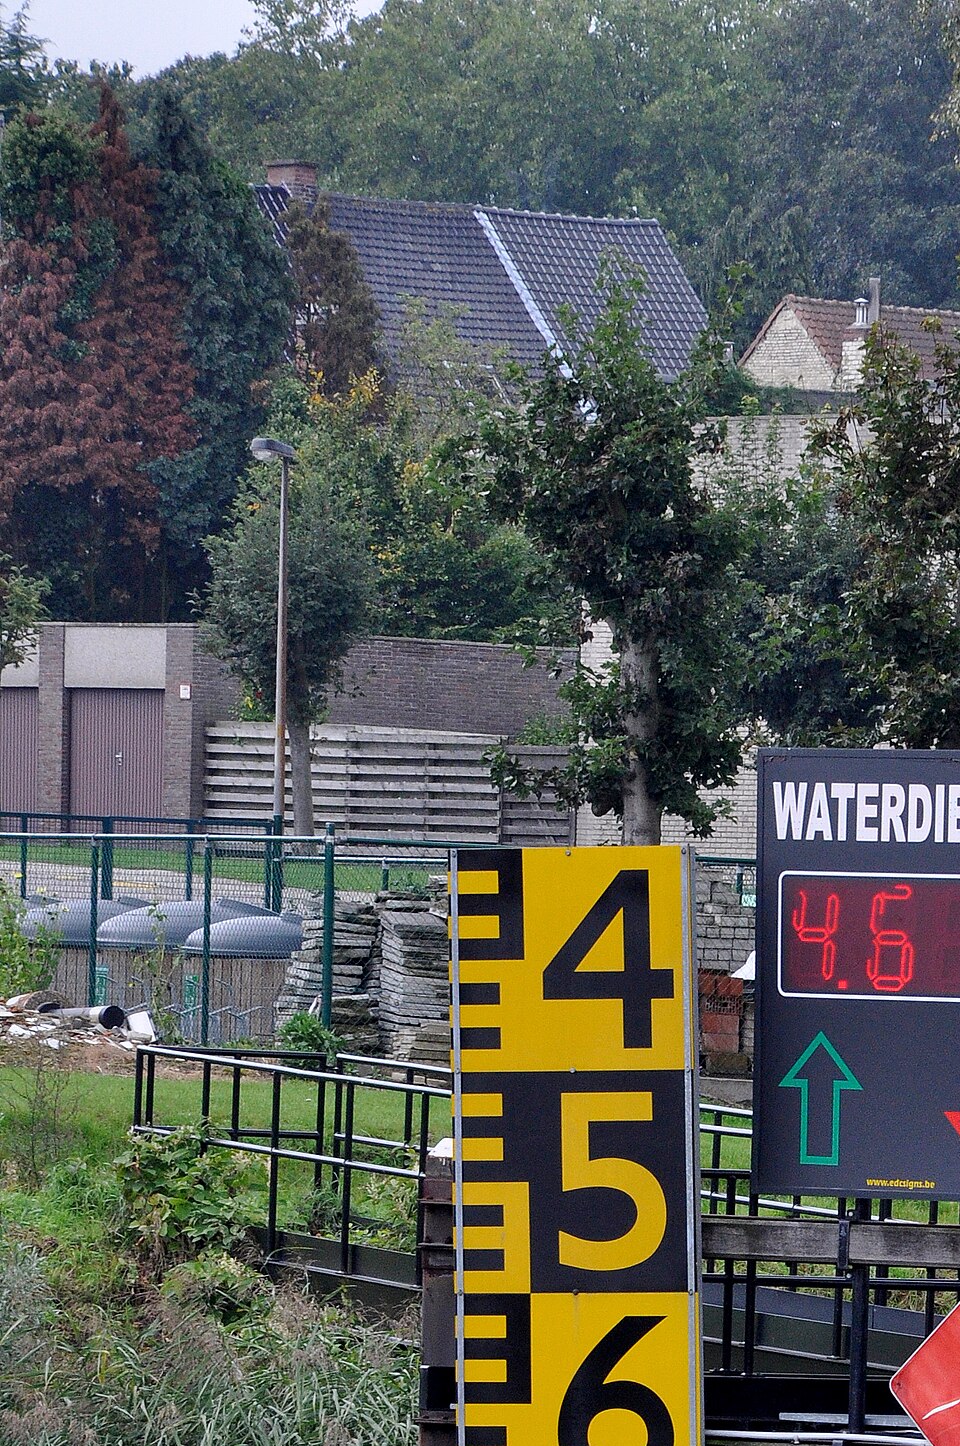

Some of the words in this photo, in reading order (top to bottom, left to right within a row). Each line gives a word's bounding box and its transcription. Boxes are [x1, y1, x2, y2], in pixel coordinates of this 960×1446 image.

[543, 869, 675, 1049] 4
[558, 1091, 667, 1271] 5
[866, 1178, 936, 1190] www.edcsigns.be
